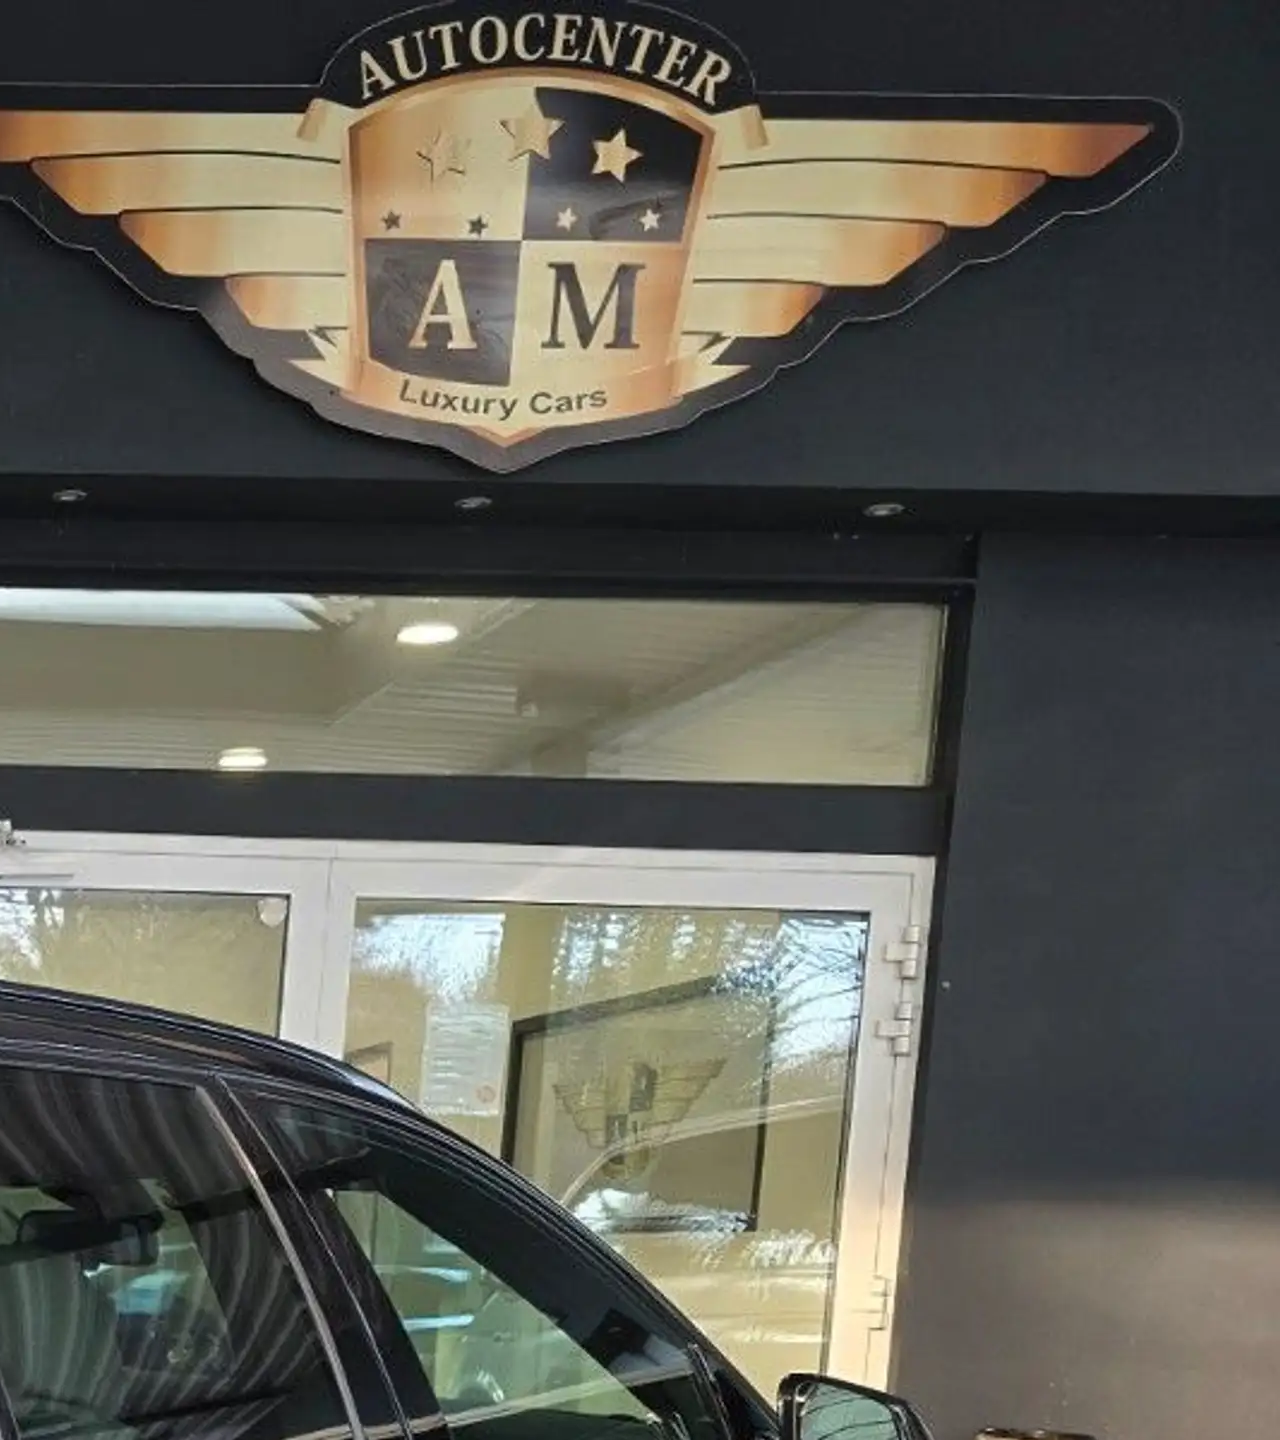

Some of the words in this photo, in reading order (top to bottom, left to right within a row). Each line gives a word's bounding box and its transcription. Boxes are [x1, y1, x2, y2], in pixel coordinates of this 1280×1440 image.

[361, 14, 732, 106] AUTOCENTER
[408, 259, 477, 349] A
[540, 261, 646, 349] M
[399, 379, 519, 421] Luxury
[530, 388, 608, 415] Cars
